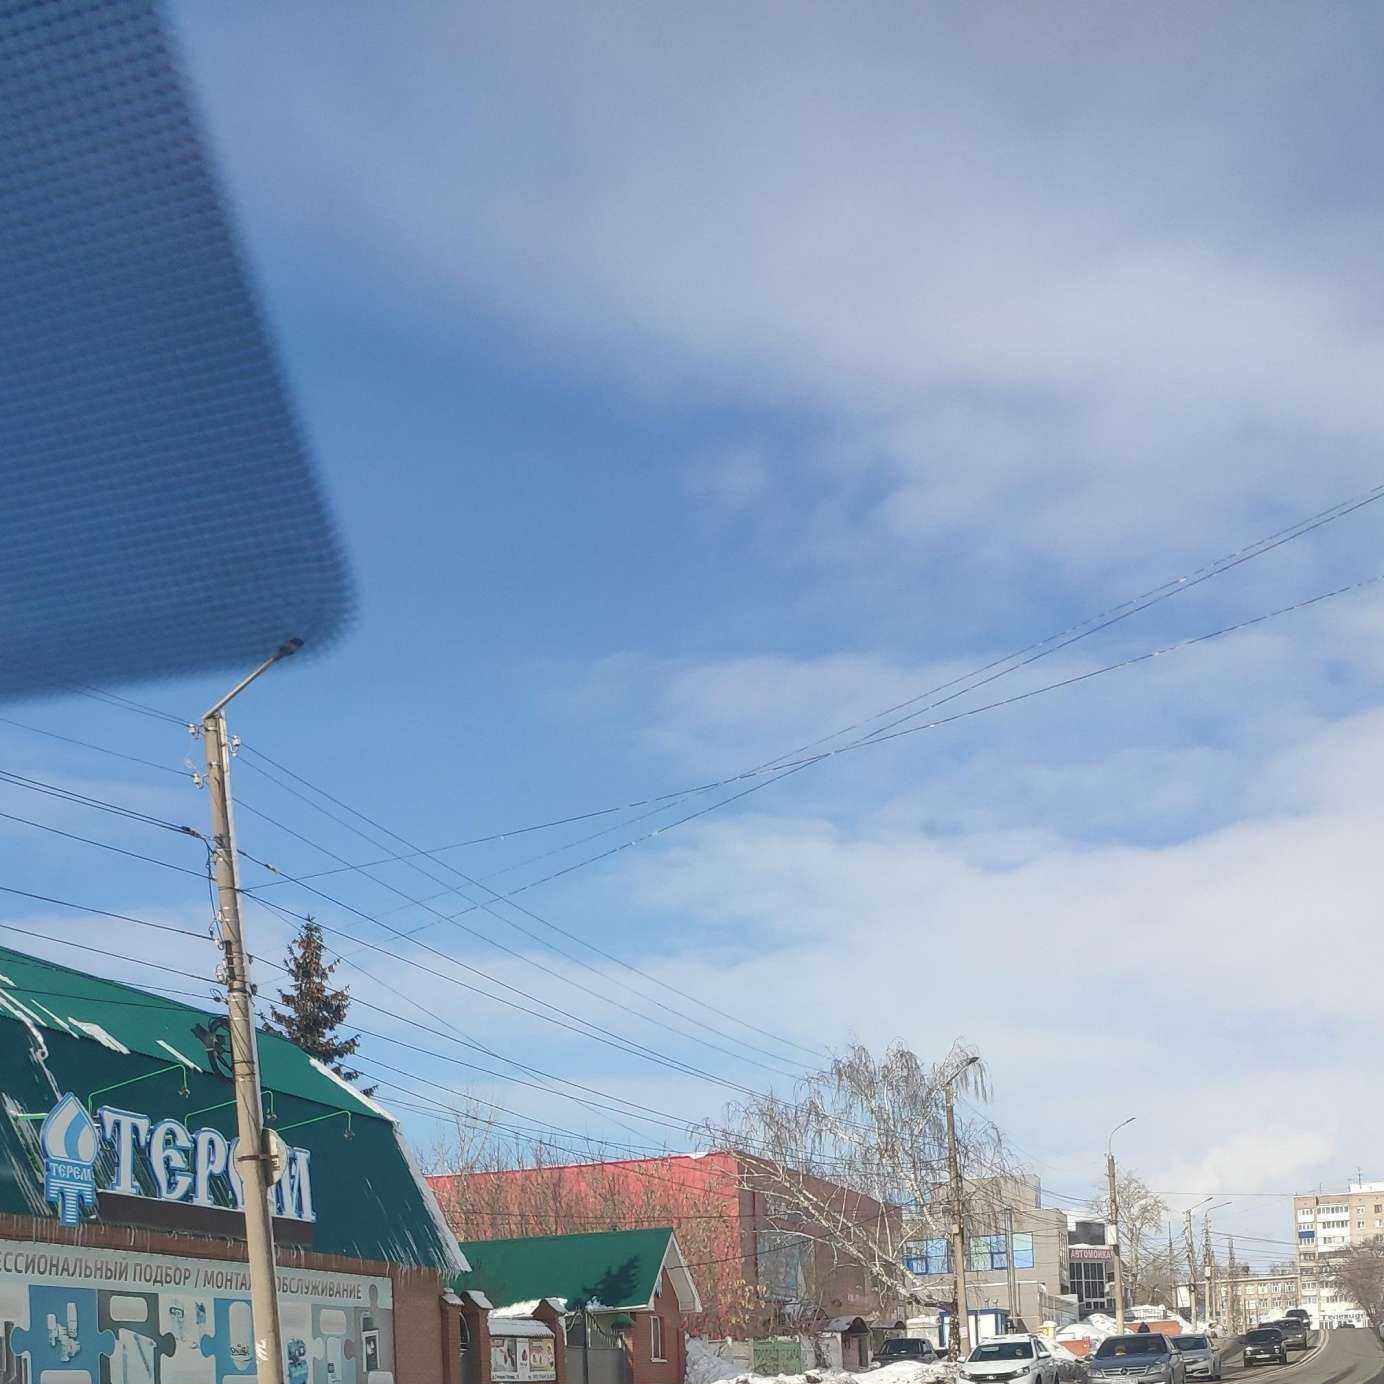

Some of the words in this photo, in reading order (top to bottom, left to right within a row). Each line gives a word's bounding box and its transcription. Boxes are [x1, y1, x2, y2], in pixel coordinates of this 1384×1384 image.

[0, 1252, 129, 1282] ССИОНАЛЬНЫЙ
[133, 1262, 191, 1287] ПОДБОР
[203, 1269, 252, 1291] МОНТА
